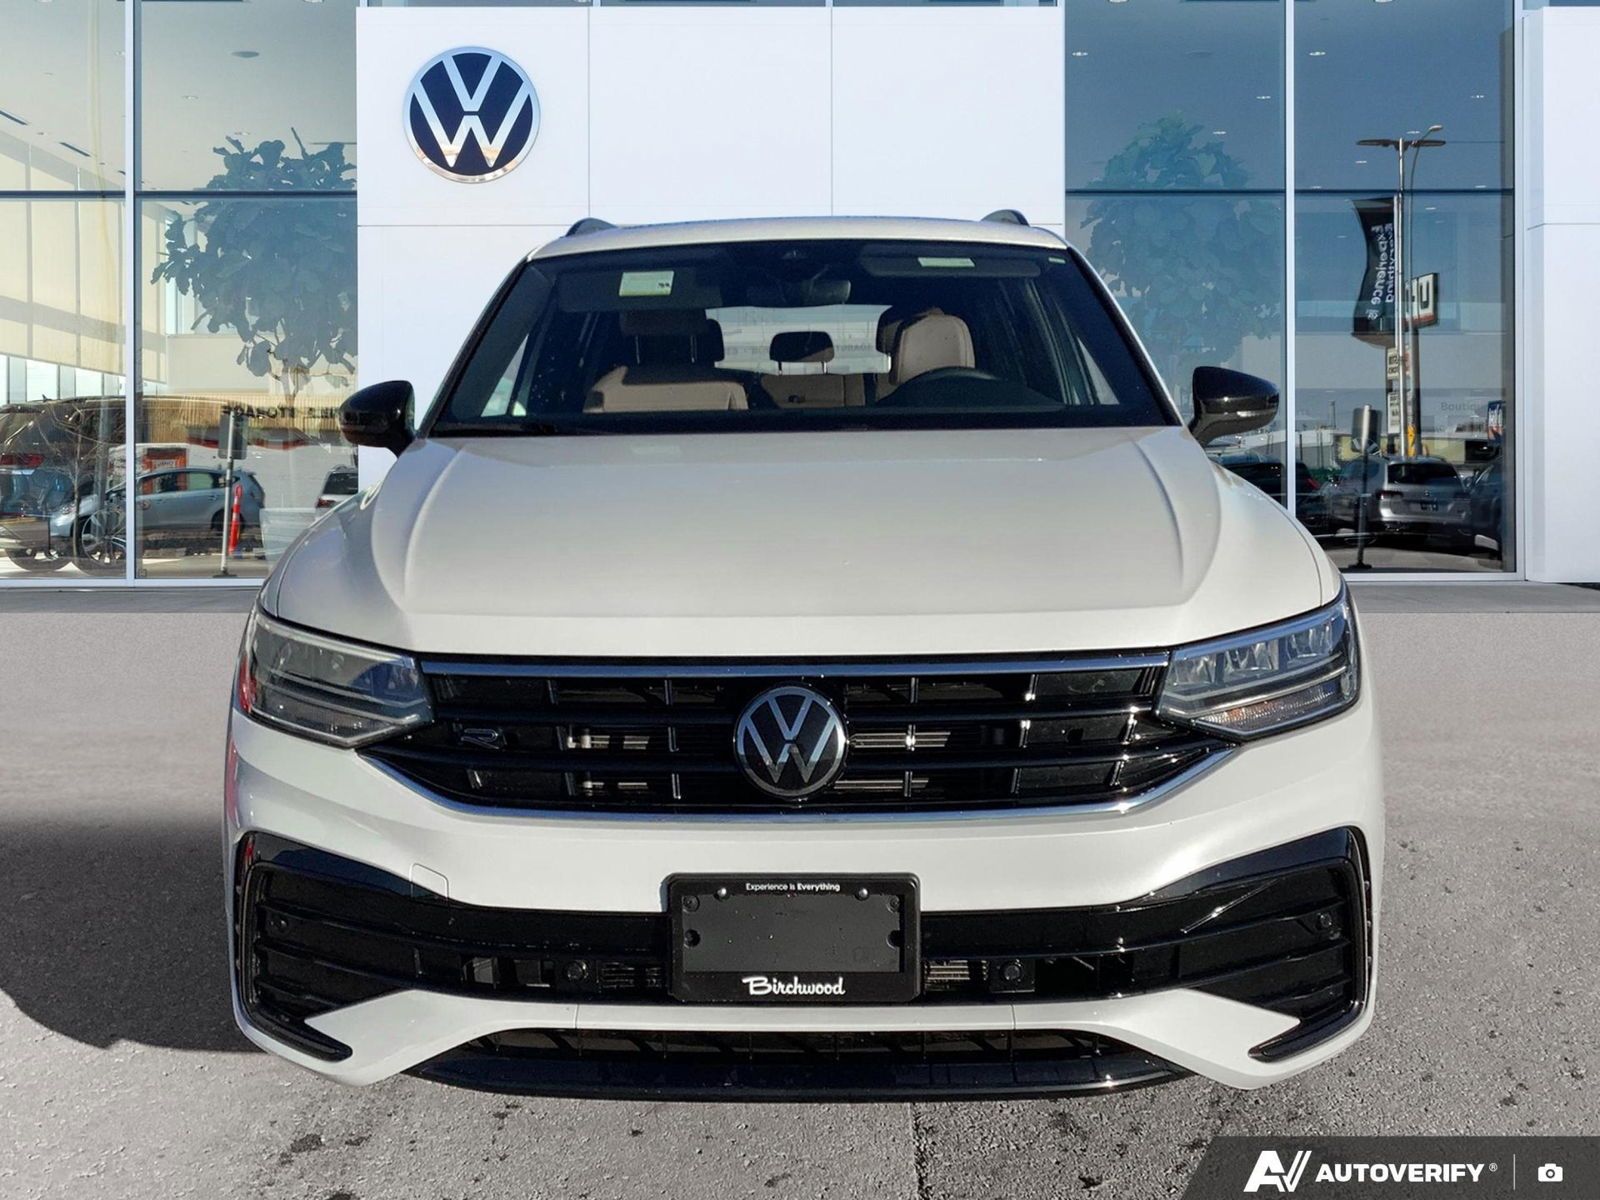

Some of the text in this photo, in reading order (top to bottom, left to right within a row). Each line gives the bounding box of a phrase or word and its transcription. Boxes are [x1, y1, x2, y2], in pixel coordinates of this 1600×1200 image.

[746, 883, 788, 892] Experience
[797, 883, 840, 892] Everything
[742, 976, 846, 995] Birchwood
